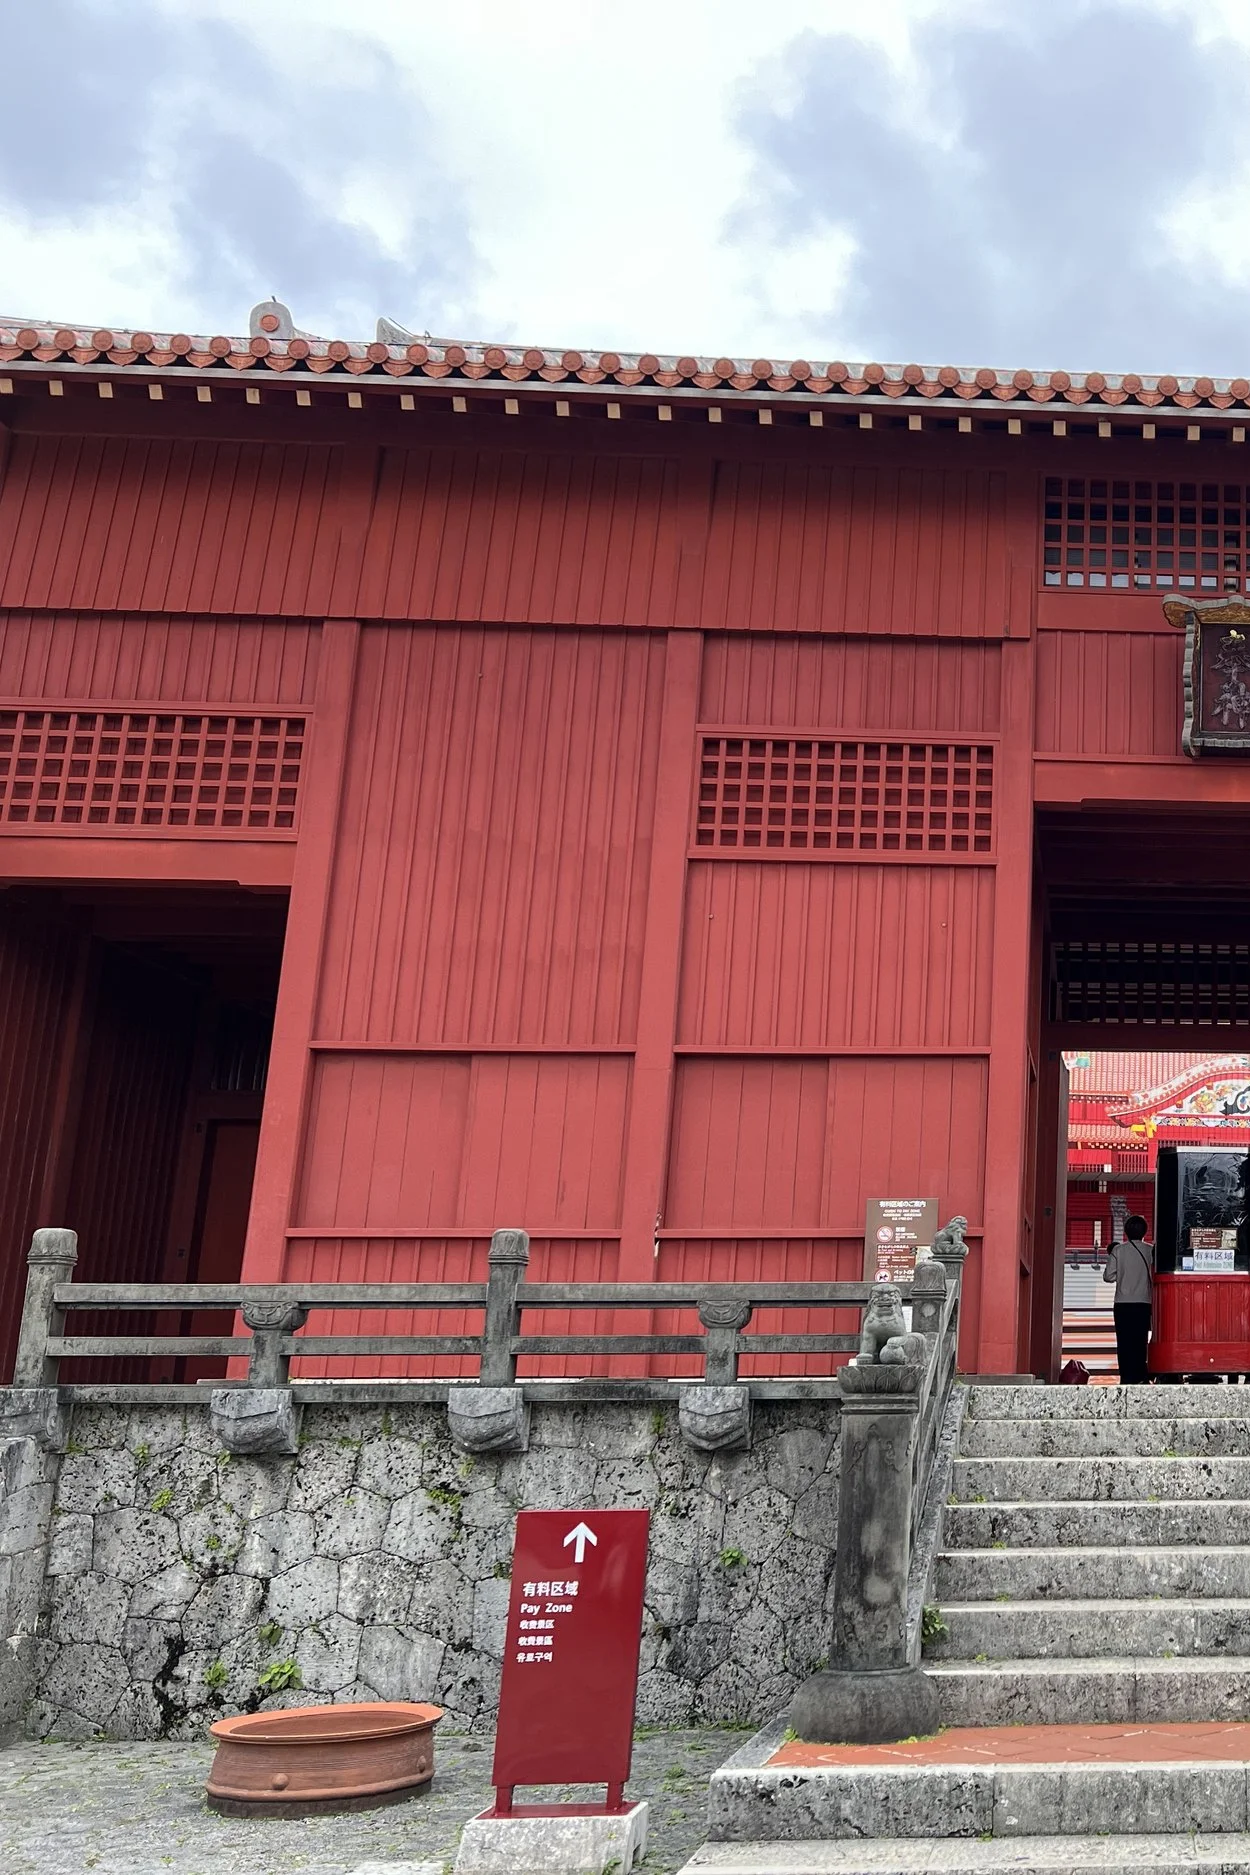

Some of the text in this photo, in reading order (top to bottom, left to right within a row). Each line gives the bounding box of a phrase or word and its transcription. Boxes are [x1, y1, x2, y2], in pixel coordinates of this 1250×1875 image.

[1195, 1251, 1233, 1260] 有料区域
[523, 1581, 578, 1597] 有料区域
[520, 1603, 572, 1615] Pay Zone
